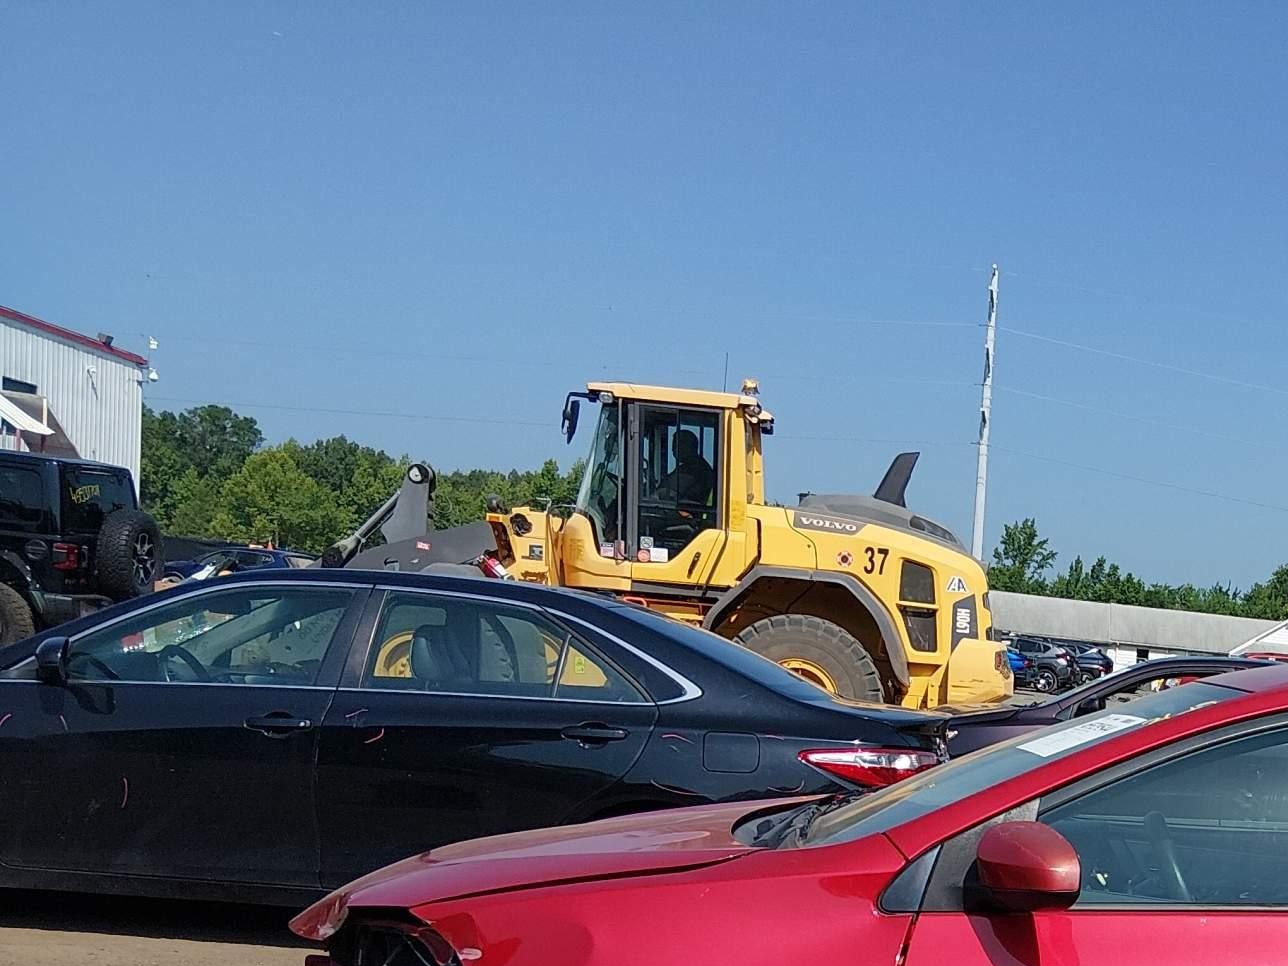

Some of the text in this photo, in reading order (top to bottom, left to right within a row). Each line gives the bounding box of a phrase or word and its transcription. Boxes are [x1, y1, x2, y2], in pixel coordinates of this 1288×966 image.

[800, 517, 857, 531] VOLVO
[863, 546, 890, 576] 37
[956, 608, 971, 634] L90H
